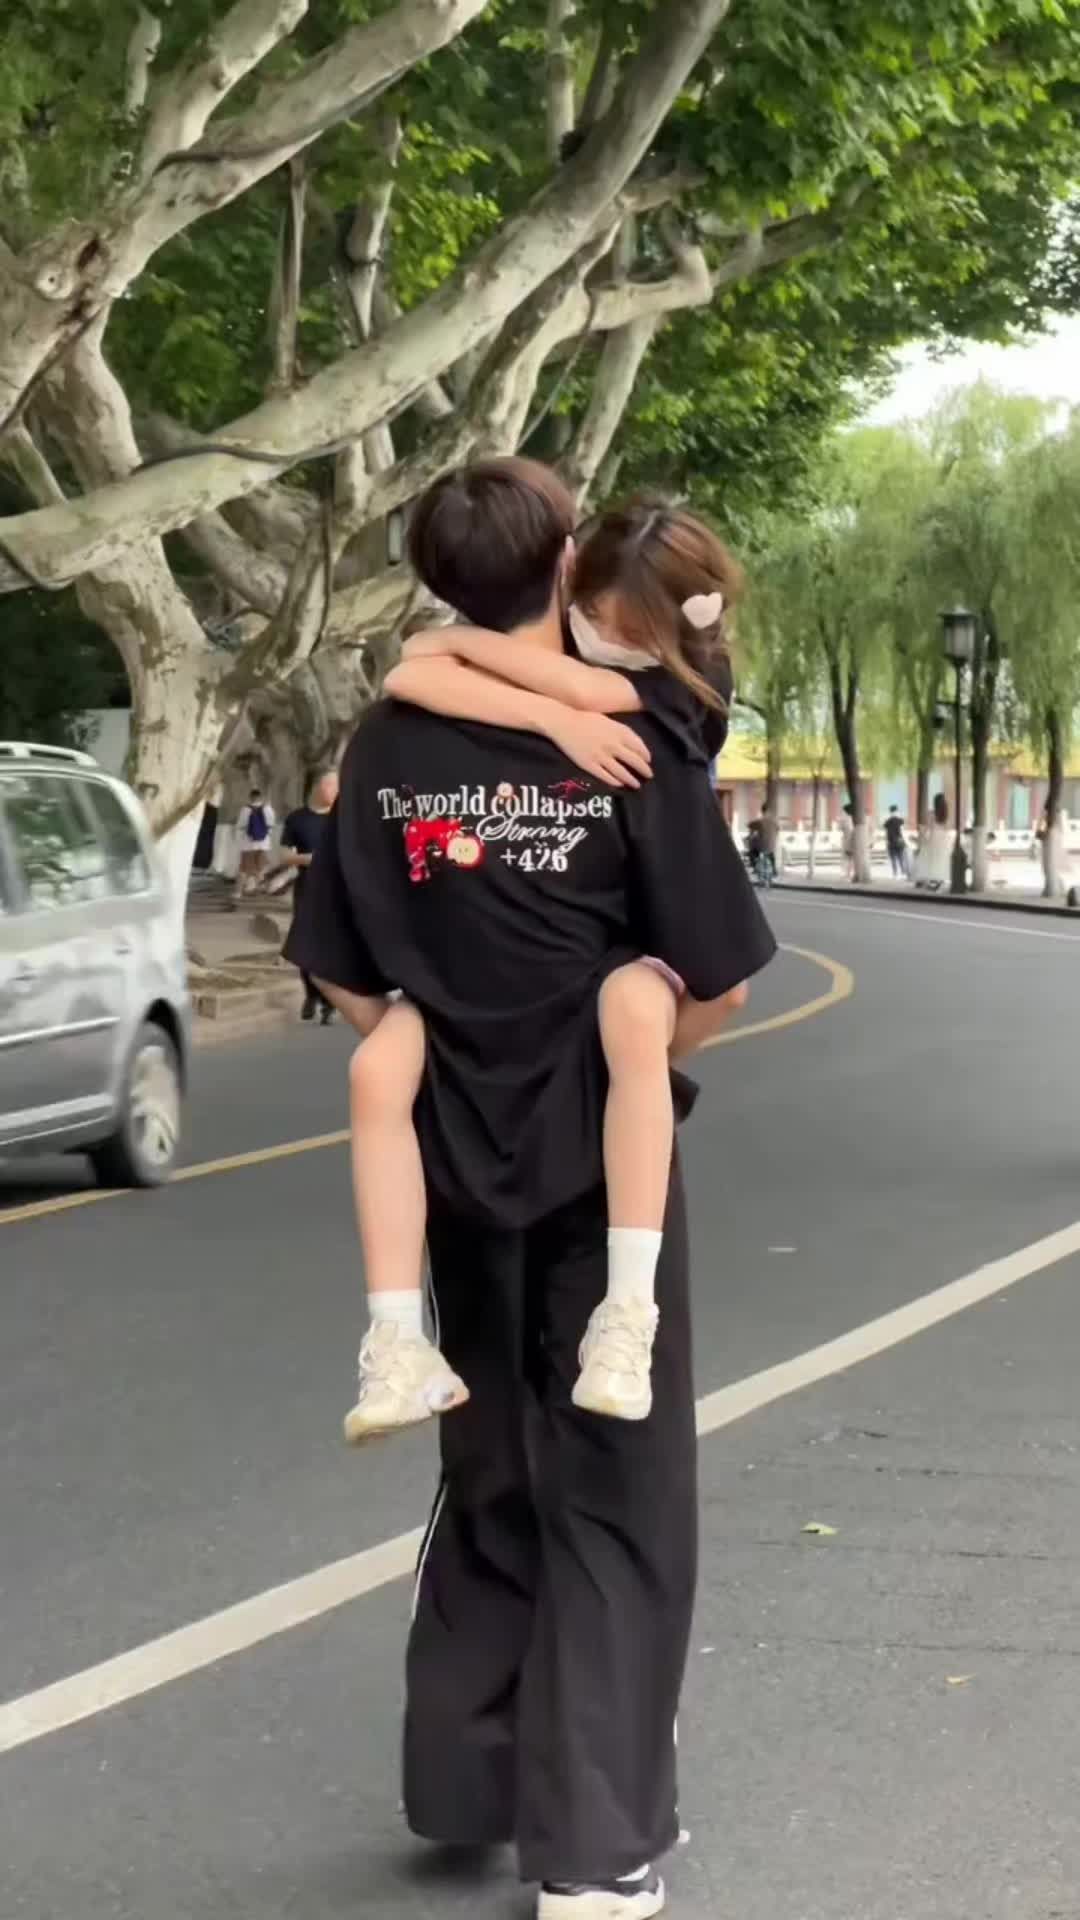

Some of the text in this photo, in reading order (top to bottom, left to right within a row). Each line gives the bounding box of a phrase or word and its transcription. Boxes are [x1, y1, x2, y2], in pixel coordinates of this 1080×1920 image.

[377, 784, 612, 825] The world collapses
